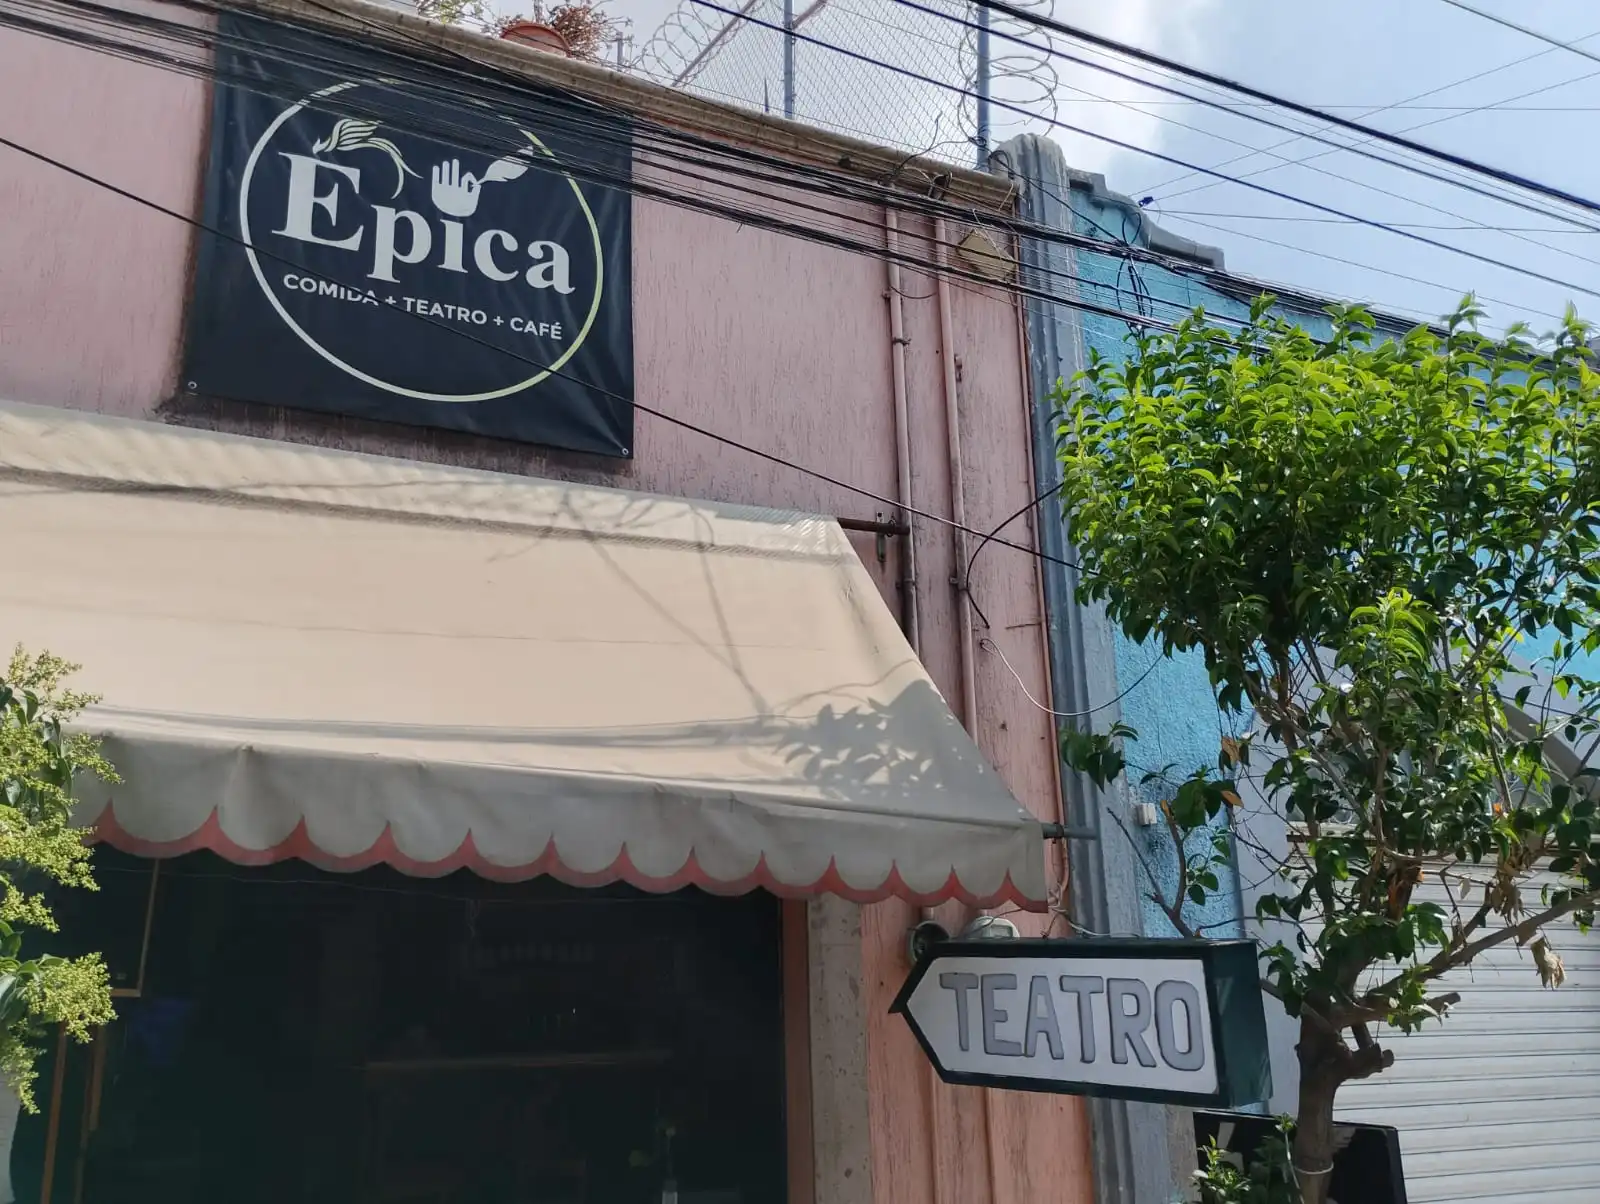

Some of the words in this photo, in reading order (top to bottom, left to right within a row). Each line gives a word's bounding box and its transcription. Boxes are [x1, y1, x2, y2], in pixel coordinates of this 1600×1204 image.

[283, 274, 379, 306] COMIDA
[403, 296, 488, 325] TEATRO
[510, 317, 562, 340] CAFÉ
[939, 972, 1205, 1071] TEATRO
